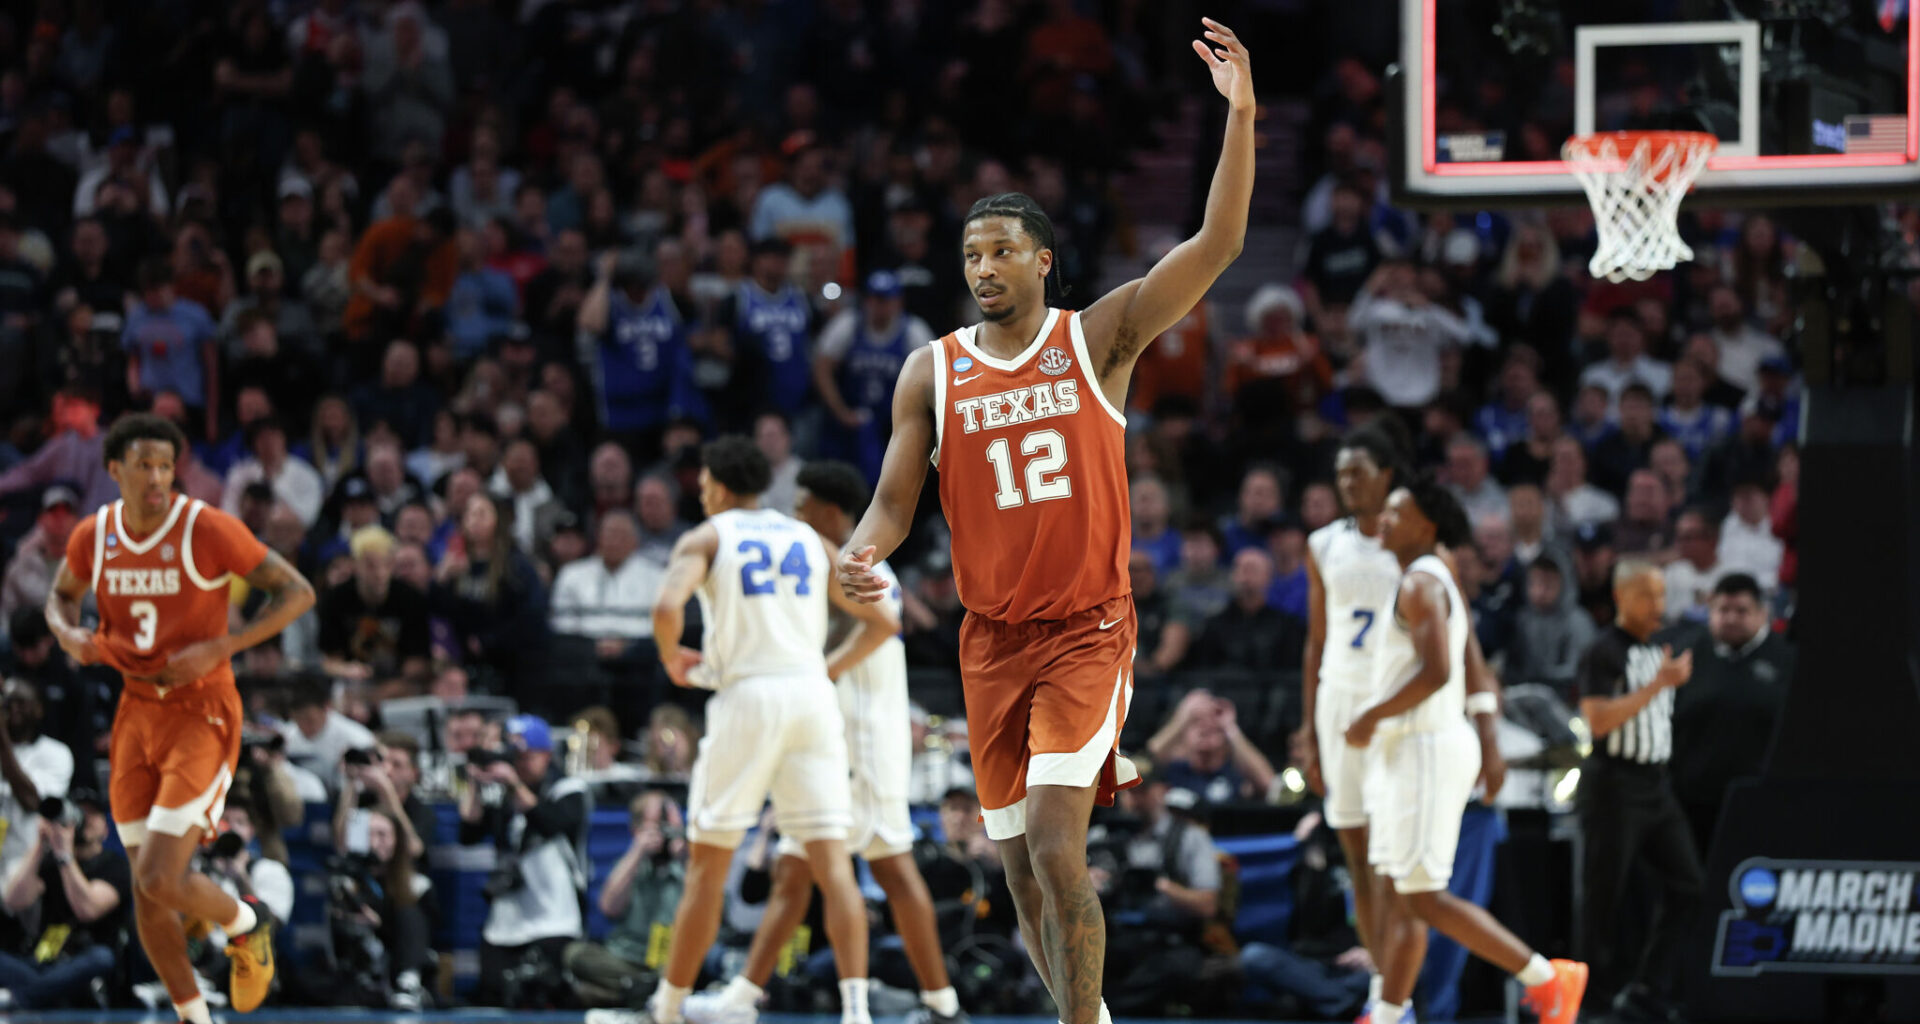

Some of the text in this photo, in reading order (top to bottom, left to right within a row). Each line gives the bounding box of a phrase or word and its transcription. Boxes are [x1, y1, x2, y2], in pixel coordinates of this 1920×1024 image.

[1042, 348, 1066, 369] SEC
[955, 379, 1080, 434] TEXAS
[986, 429, 1072, 510] 12
[105, 569, 181, 595] TEXAS
[737, 540, 811, 596] 24
[130, 601, 157, 651] 3
[1351, 609, 1375, 648] 7
[1776, 869, 1914, 911] MARCH
